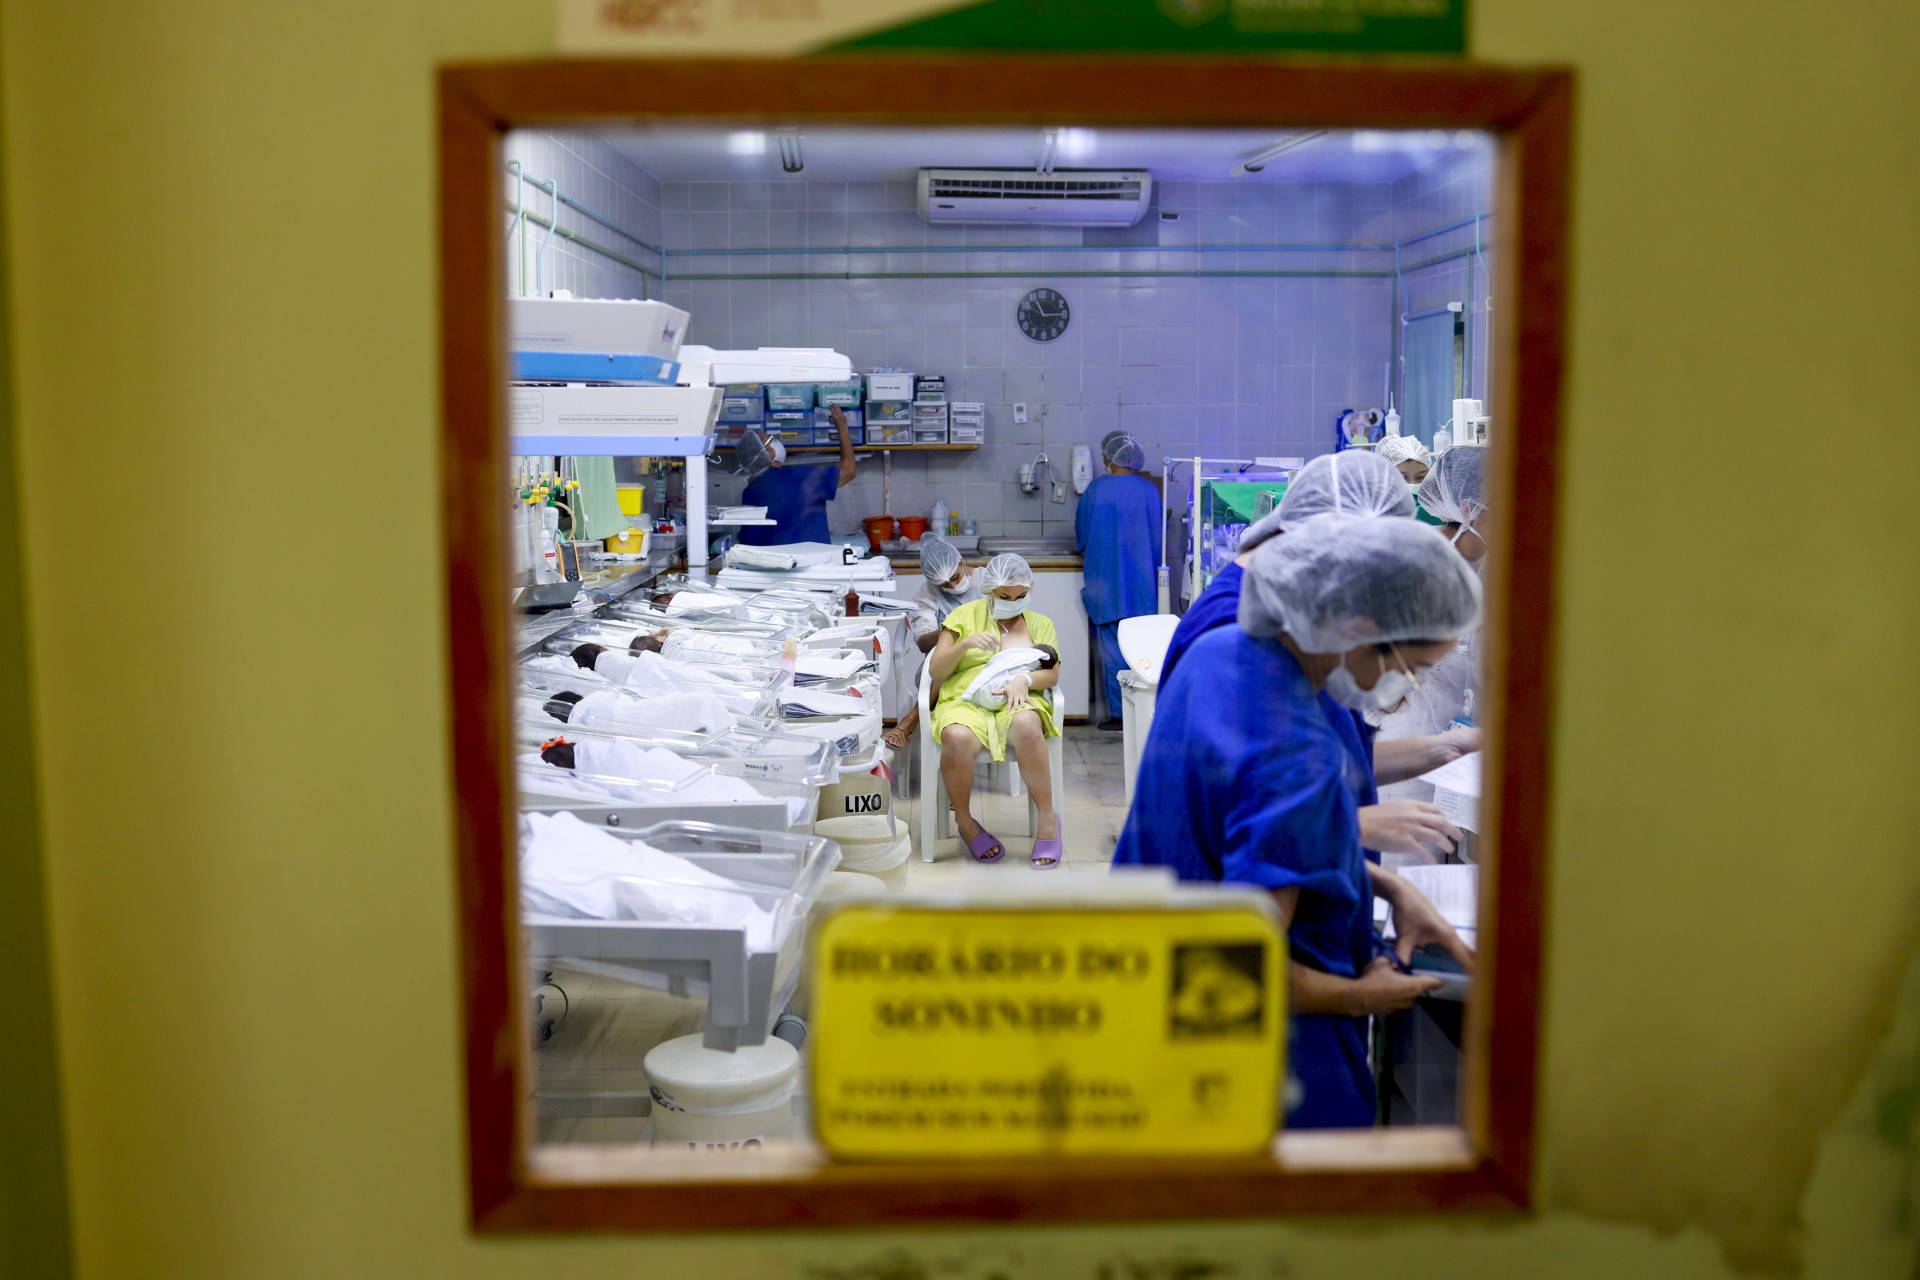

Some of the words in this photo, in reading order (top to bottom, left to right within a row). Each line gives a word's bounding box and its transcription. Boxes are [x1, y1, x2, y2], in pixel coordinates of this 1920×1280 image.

[1030, 293, 1036, 302] 11
[1039, 290, 1047, 299] 12
[1051, 292, 1056, 301] 1
[1021, 301, 1030, 310] 10
[1058, 299, 1064, 308] 2
[1031, 327, 1037, 337] 7
[845, 794, 882, 813] LIXO
[831, 935, 1067, 982] HORÁRIO
[1076, 942, 1151, 982] DO
[875, 996, 1103, 1035] SONINHO
